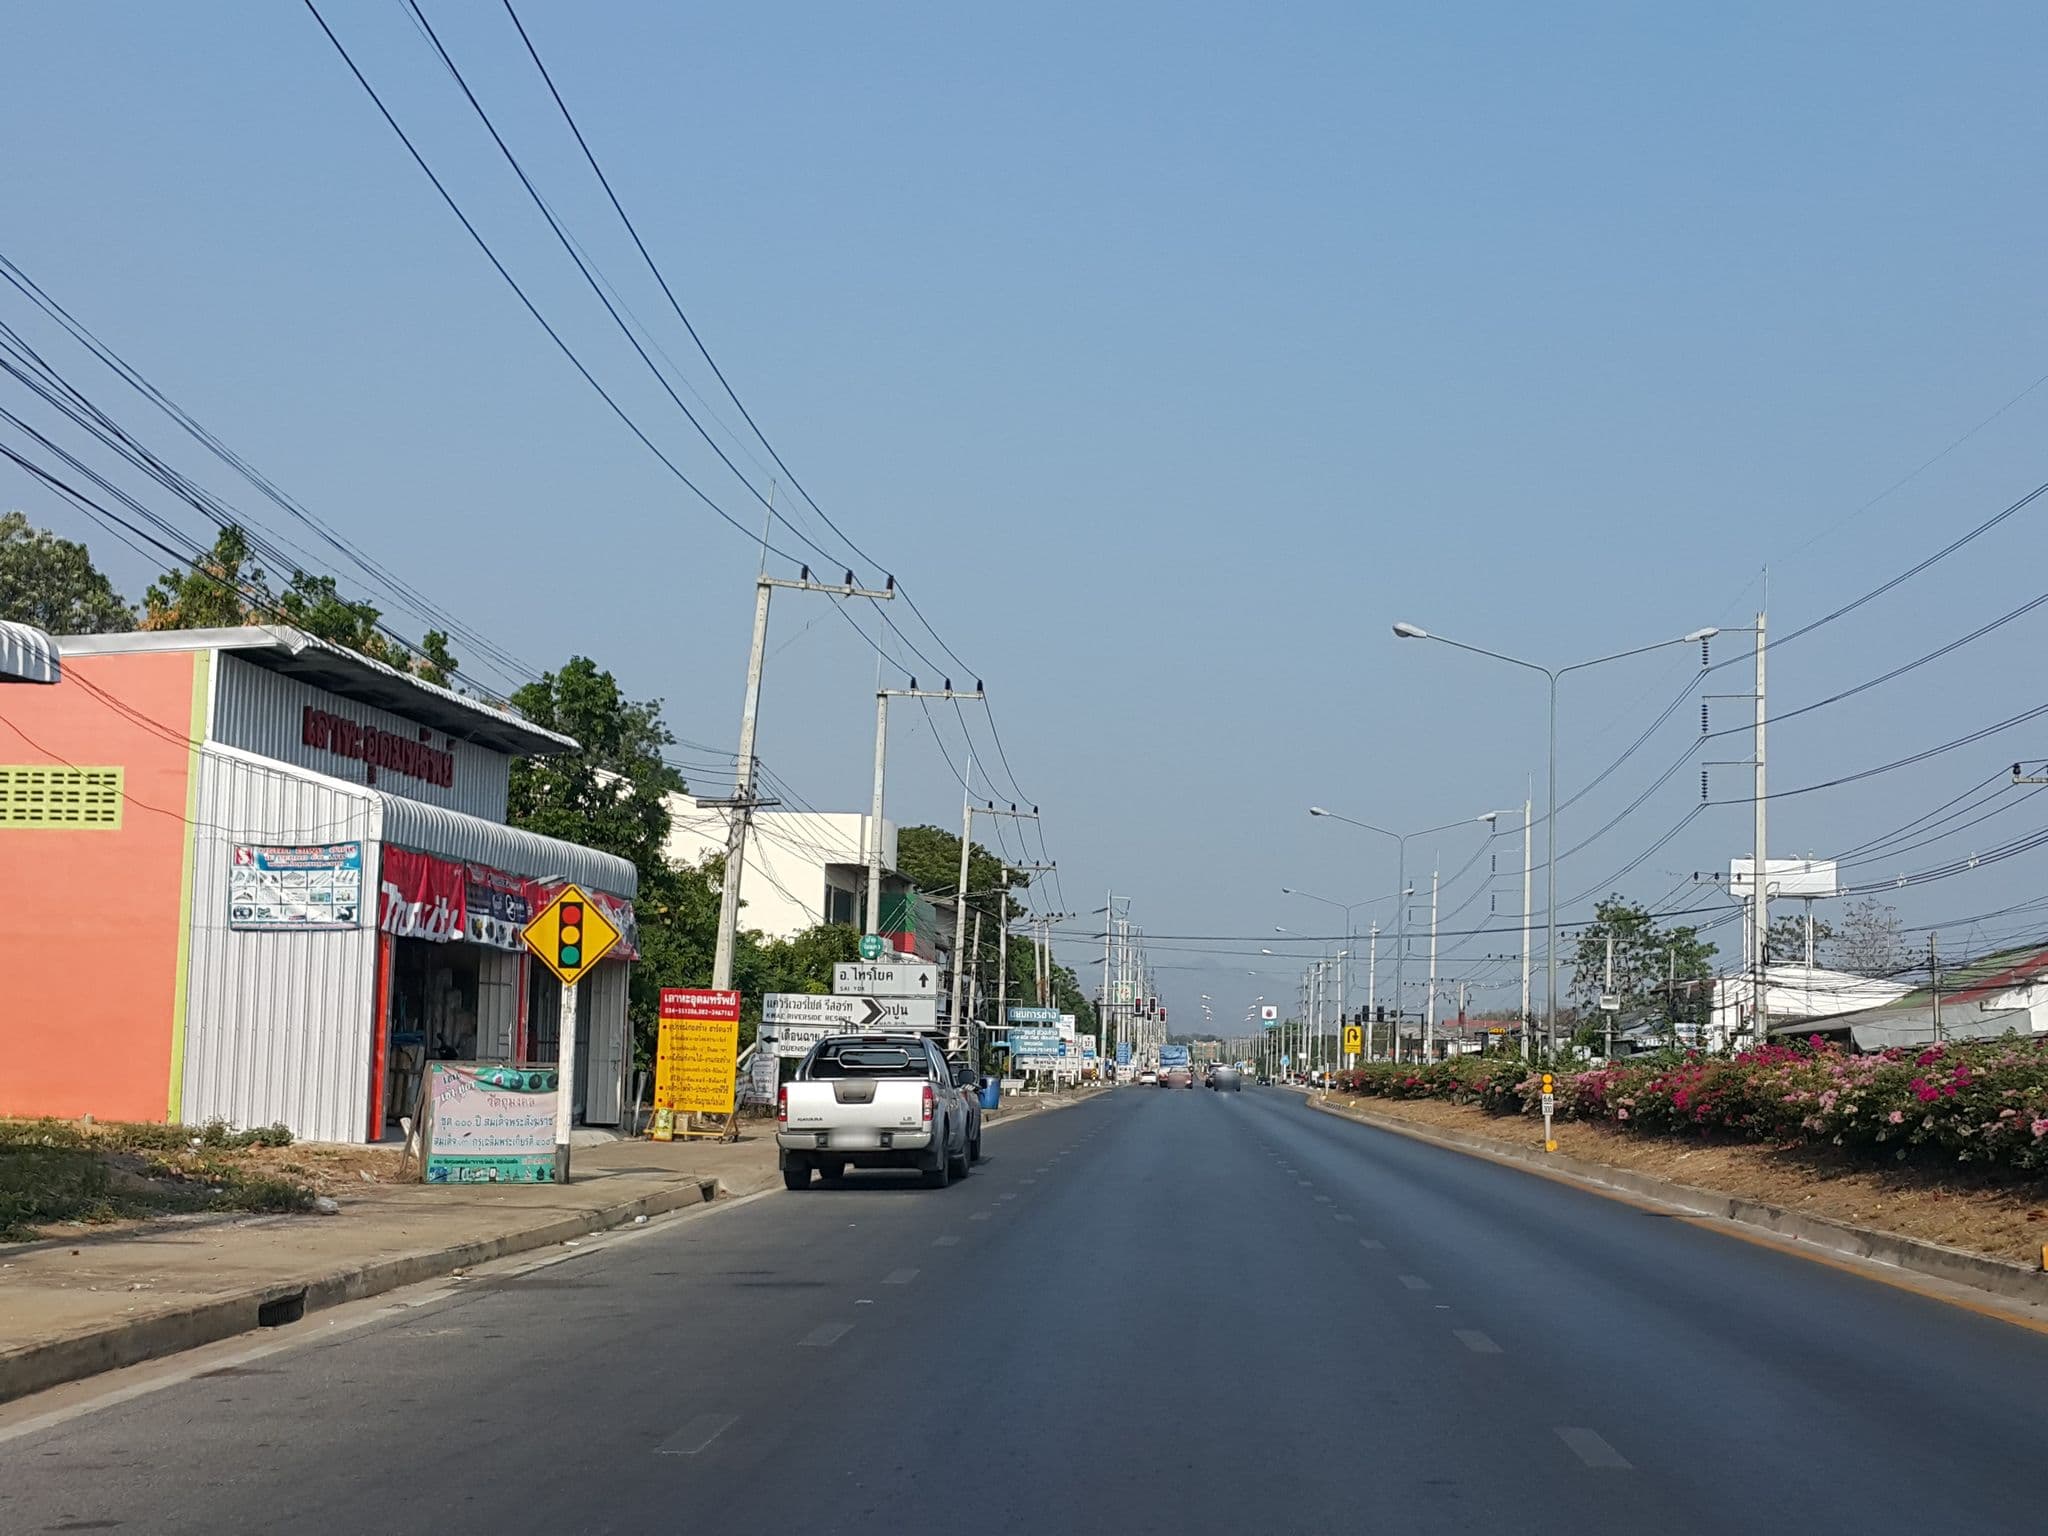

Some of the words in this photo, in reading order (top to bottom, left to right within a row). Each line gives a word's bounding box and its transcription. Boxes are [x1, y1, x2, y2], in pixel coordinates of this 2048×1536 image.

[851, 967, 894, 981] ไทรโยค
[825, 998, 853, 1012] รีสอร์ท
